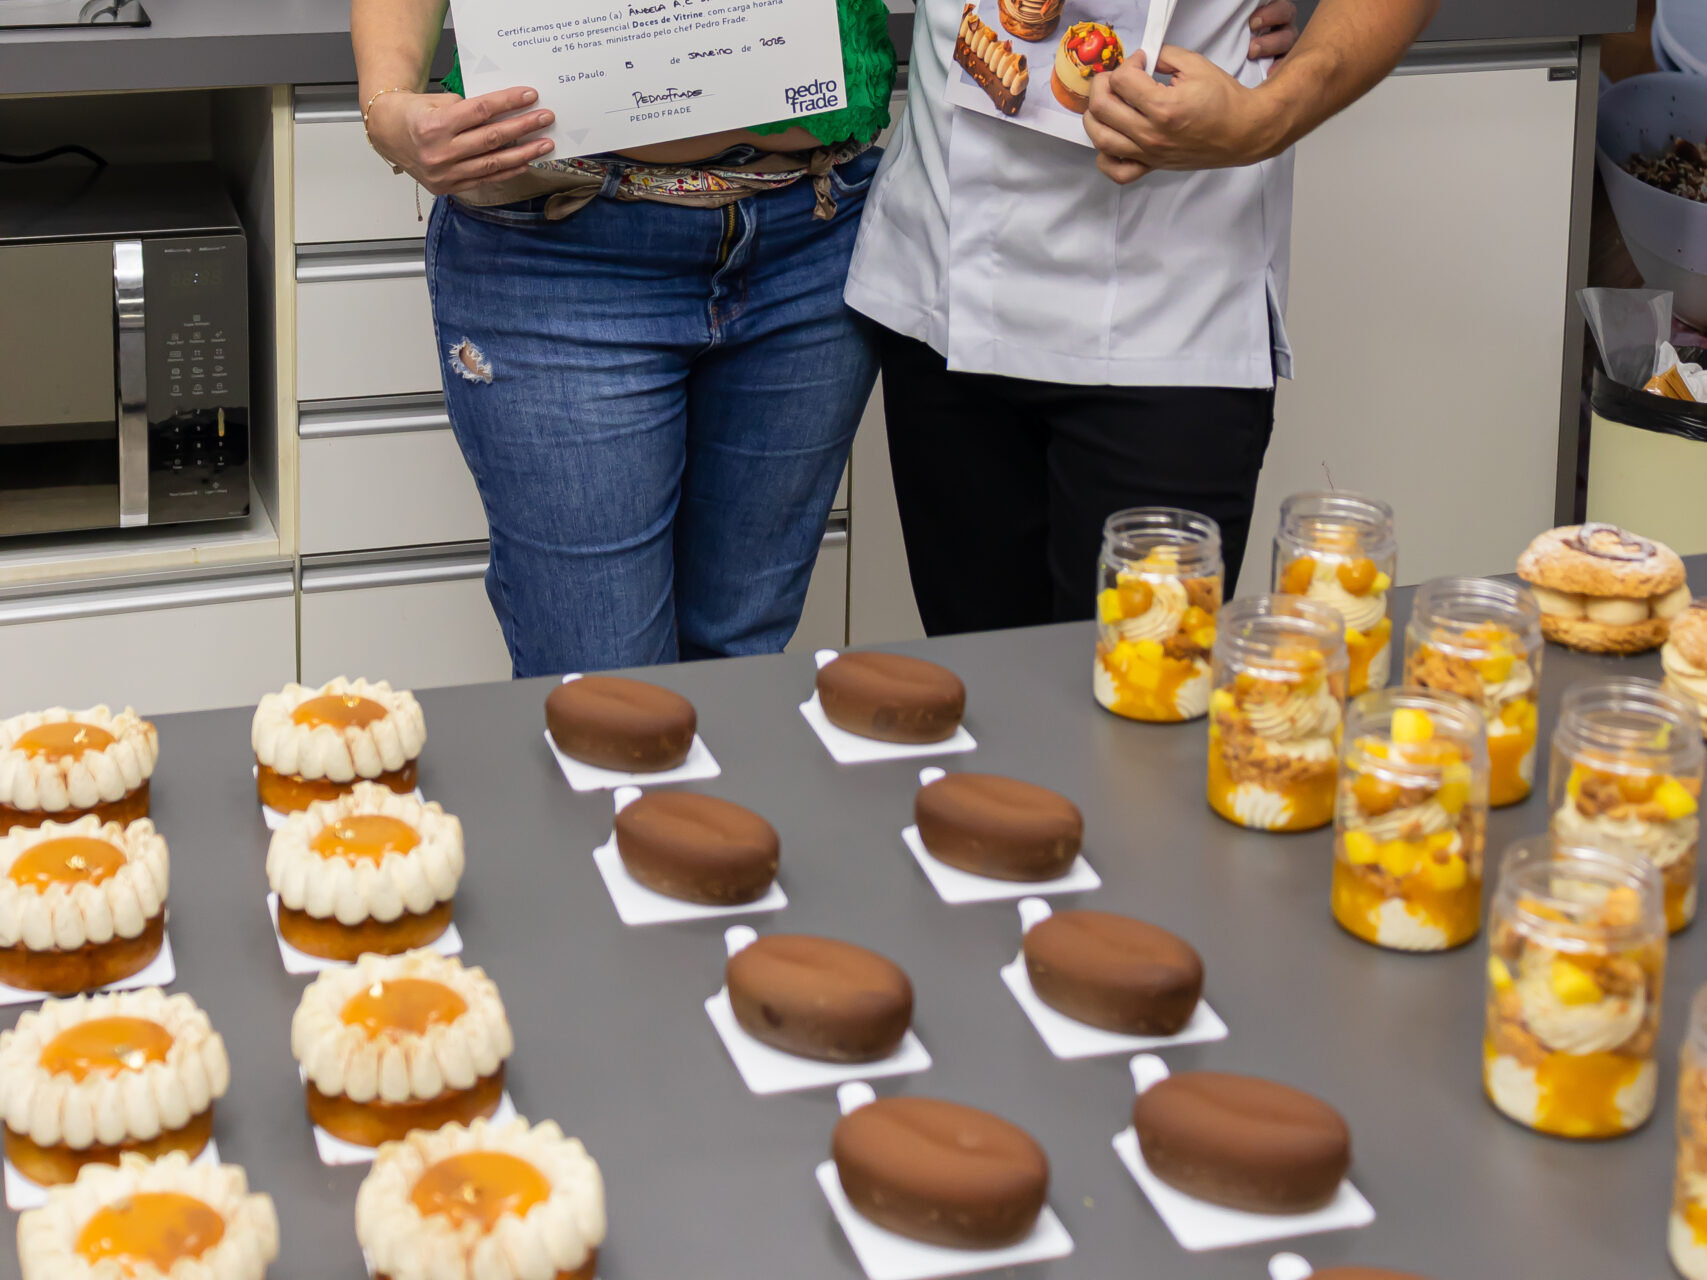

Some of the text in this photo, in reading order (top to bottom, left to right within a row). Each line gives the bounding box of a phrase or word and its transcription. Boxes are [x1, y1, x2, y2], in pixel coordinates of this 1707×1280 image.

[497, 23, 554, 37] Certificamos
[556, 20, 572, 30] que
[582, 15, 607, 25] aluno
[609, 10, 623, 21] (a)
[512, 36, 551, 48] concluiu
[561, 30, 585, 40] curso
[587, 22, 630, 38] presencial
[632, 19, 659, 29] Doces
[661, 16, 671, 24] de
[707, 7, 726, 16] com
[727, 3, 751, 14] carga
[552, 45, 562, 53] de
[564, 43, 575, 51] 16
[606, 31, 651, 45] ministrado
[653, 27, 672, 39] pelo
[674, 24, 692, 33] chef
[695, 20, 720, 30] Pedro
[558, 74, 576, 84] São
[670, 56, 680, 64] de
[741, 44, 752, 53] de
[759, 36, 786, 47] 2025
[784, 79, 837, 104] pedro
[790, 92, 839, 114] frade
[630, 105, 692, 122] PEDRO FRADE
